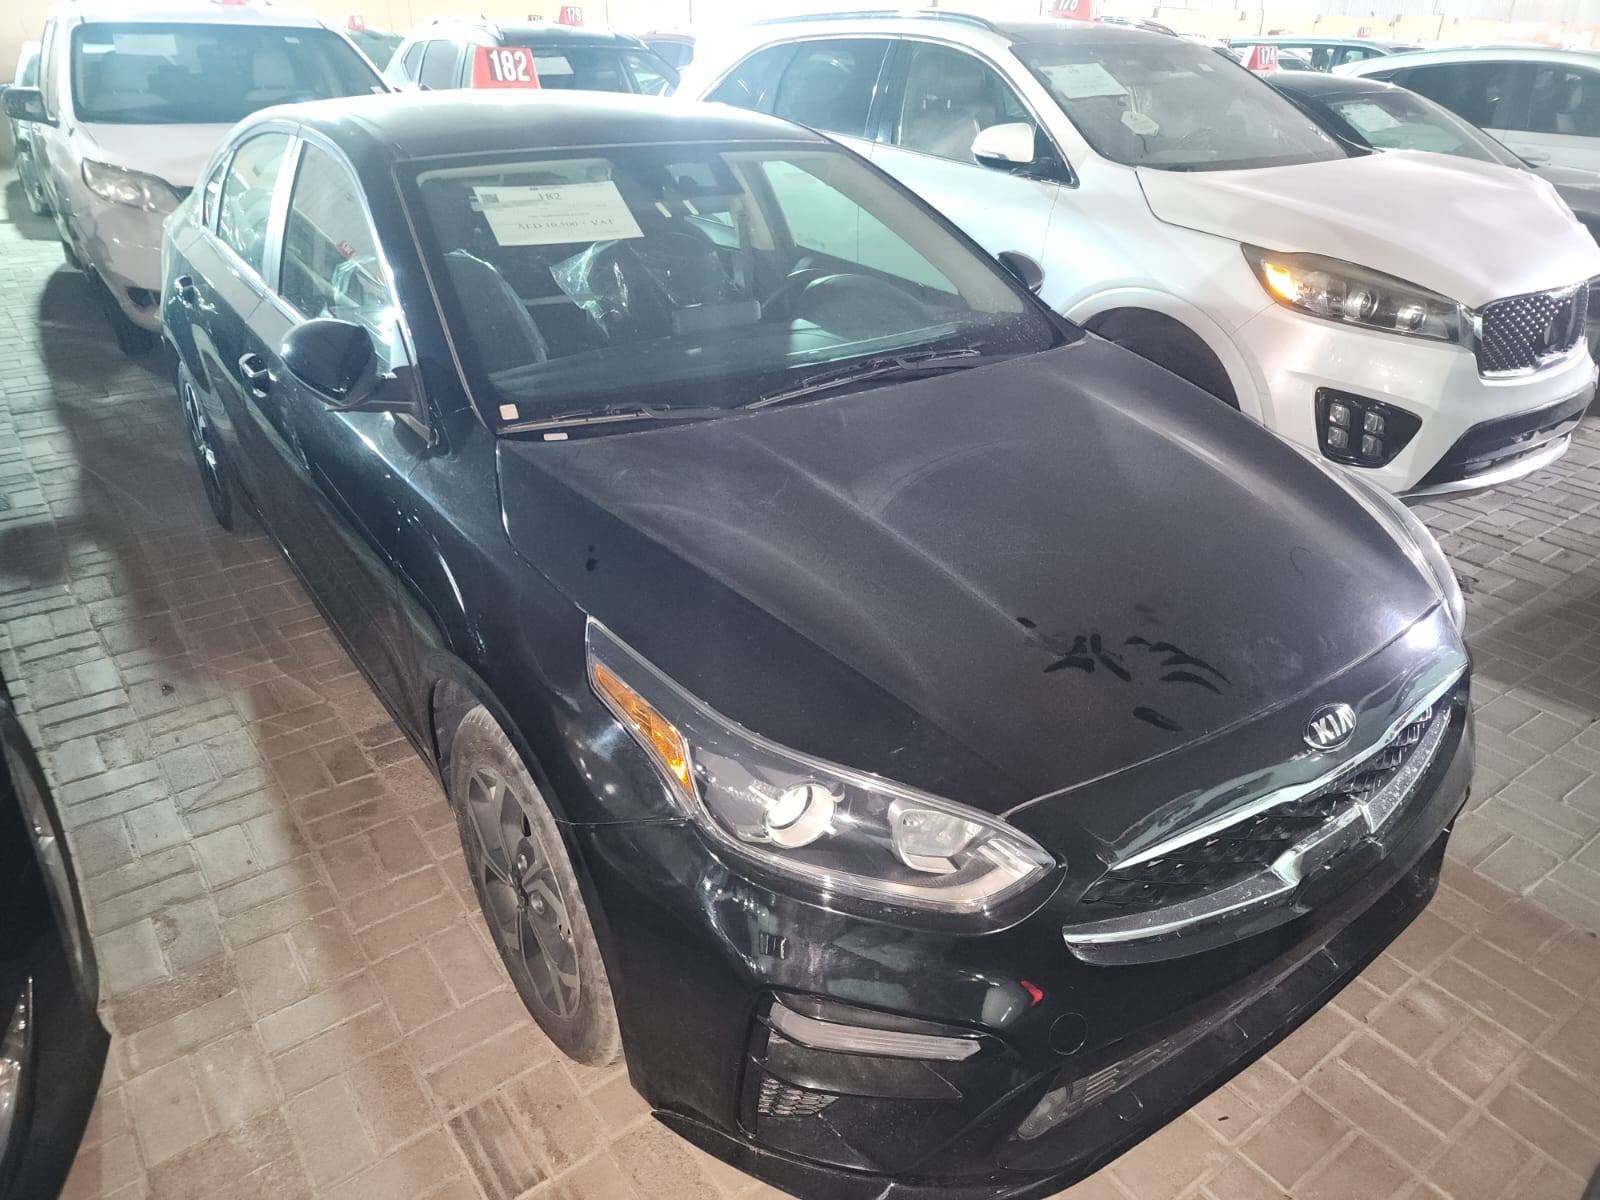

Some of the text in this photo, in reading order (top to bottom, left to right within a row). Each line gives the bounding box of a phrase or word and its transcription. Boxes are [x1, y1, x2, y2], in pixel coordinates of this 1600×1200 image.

[489, 49, 530, 82] 182
[1261, 47, 1276, 65] 174
[539, 192, 562, 202] 182
[1311, 708, 1353, 744] KIA
